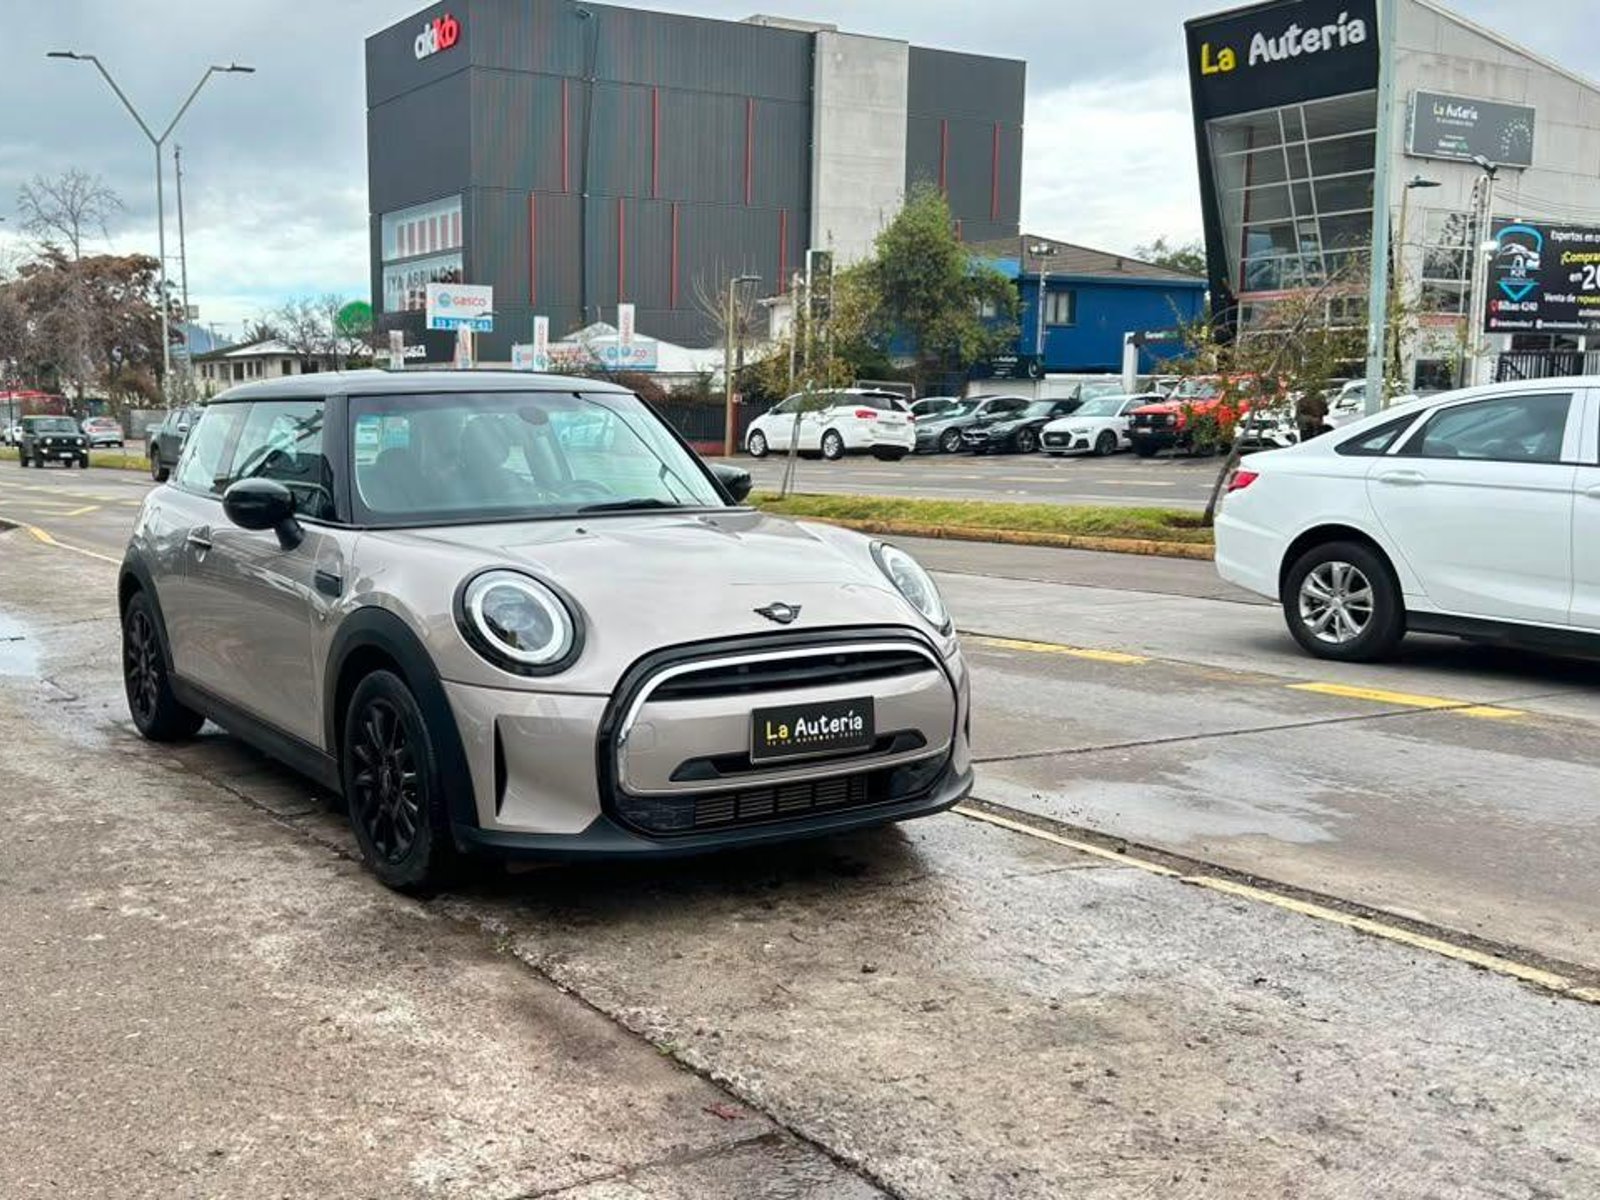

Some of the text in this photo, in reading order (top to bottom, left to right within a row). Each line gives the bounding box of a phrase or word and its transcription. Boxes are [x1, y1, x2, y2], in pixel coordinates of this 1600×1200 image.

[1201, 11, 1367, 75] La Autería
[1432, 102, 1444, 116] La
[766, 720, 789, 740] La
[794, 710, 863, 737] Autería
